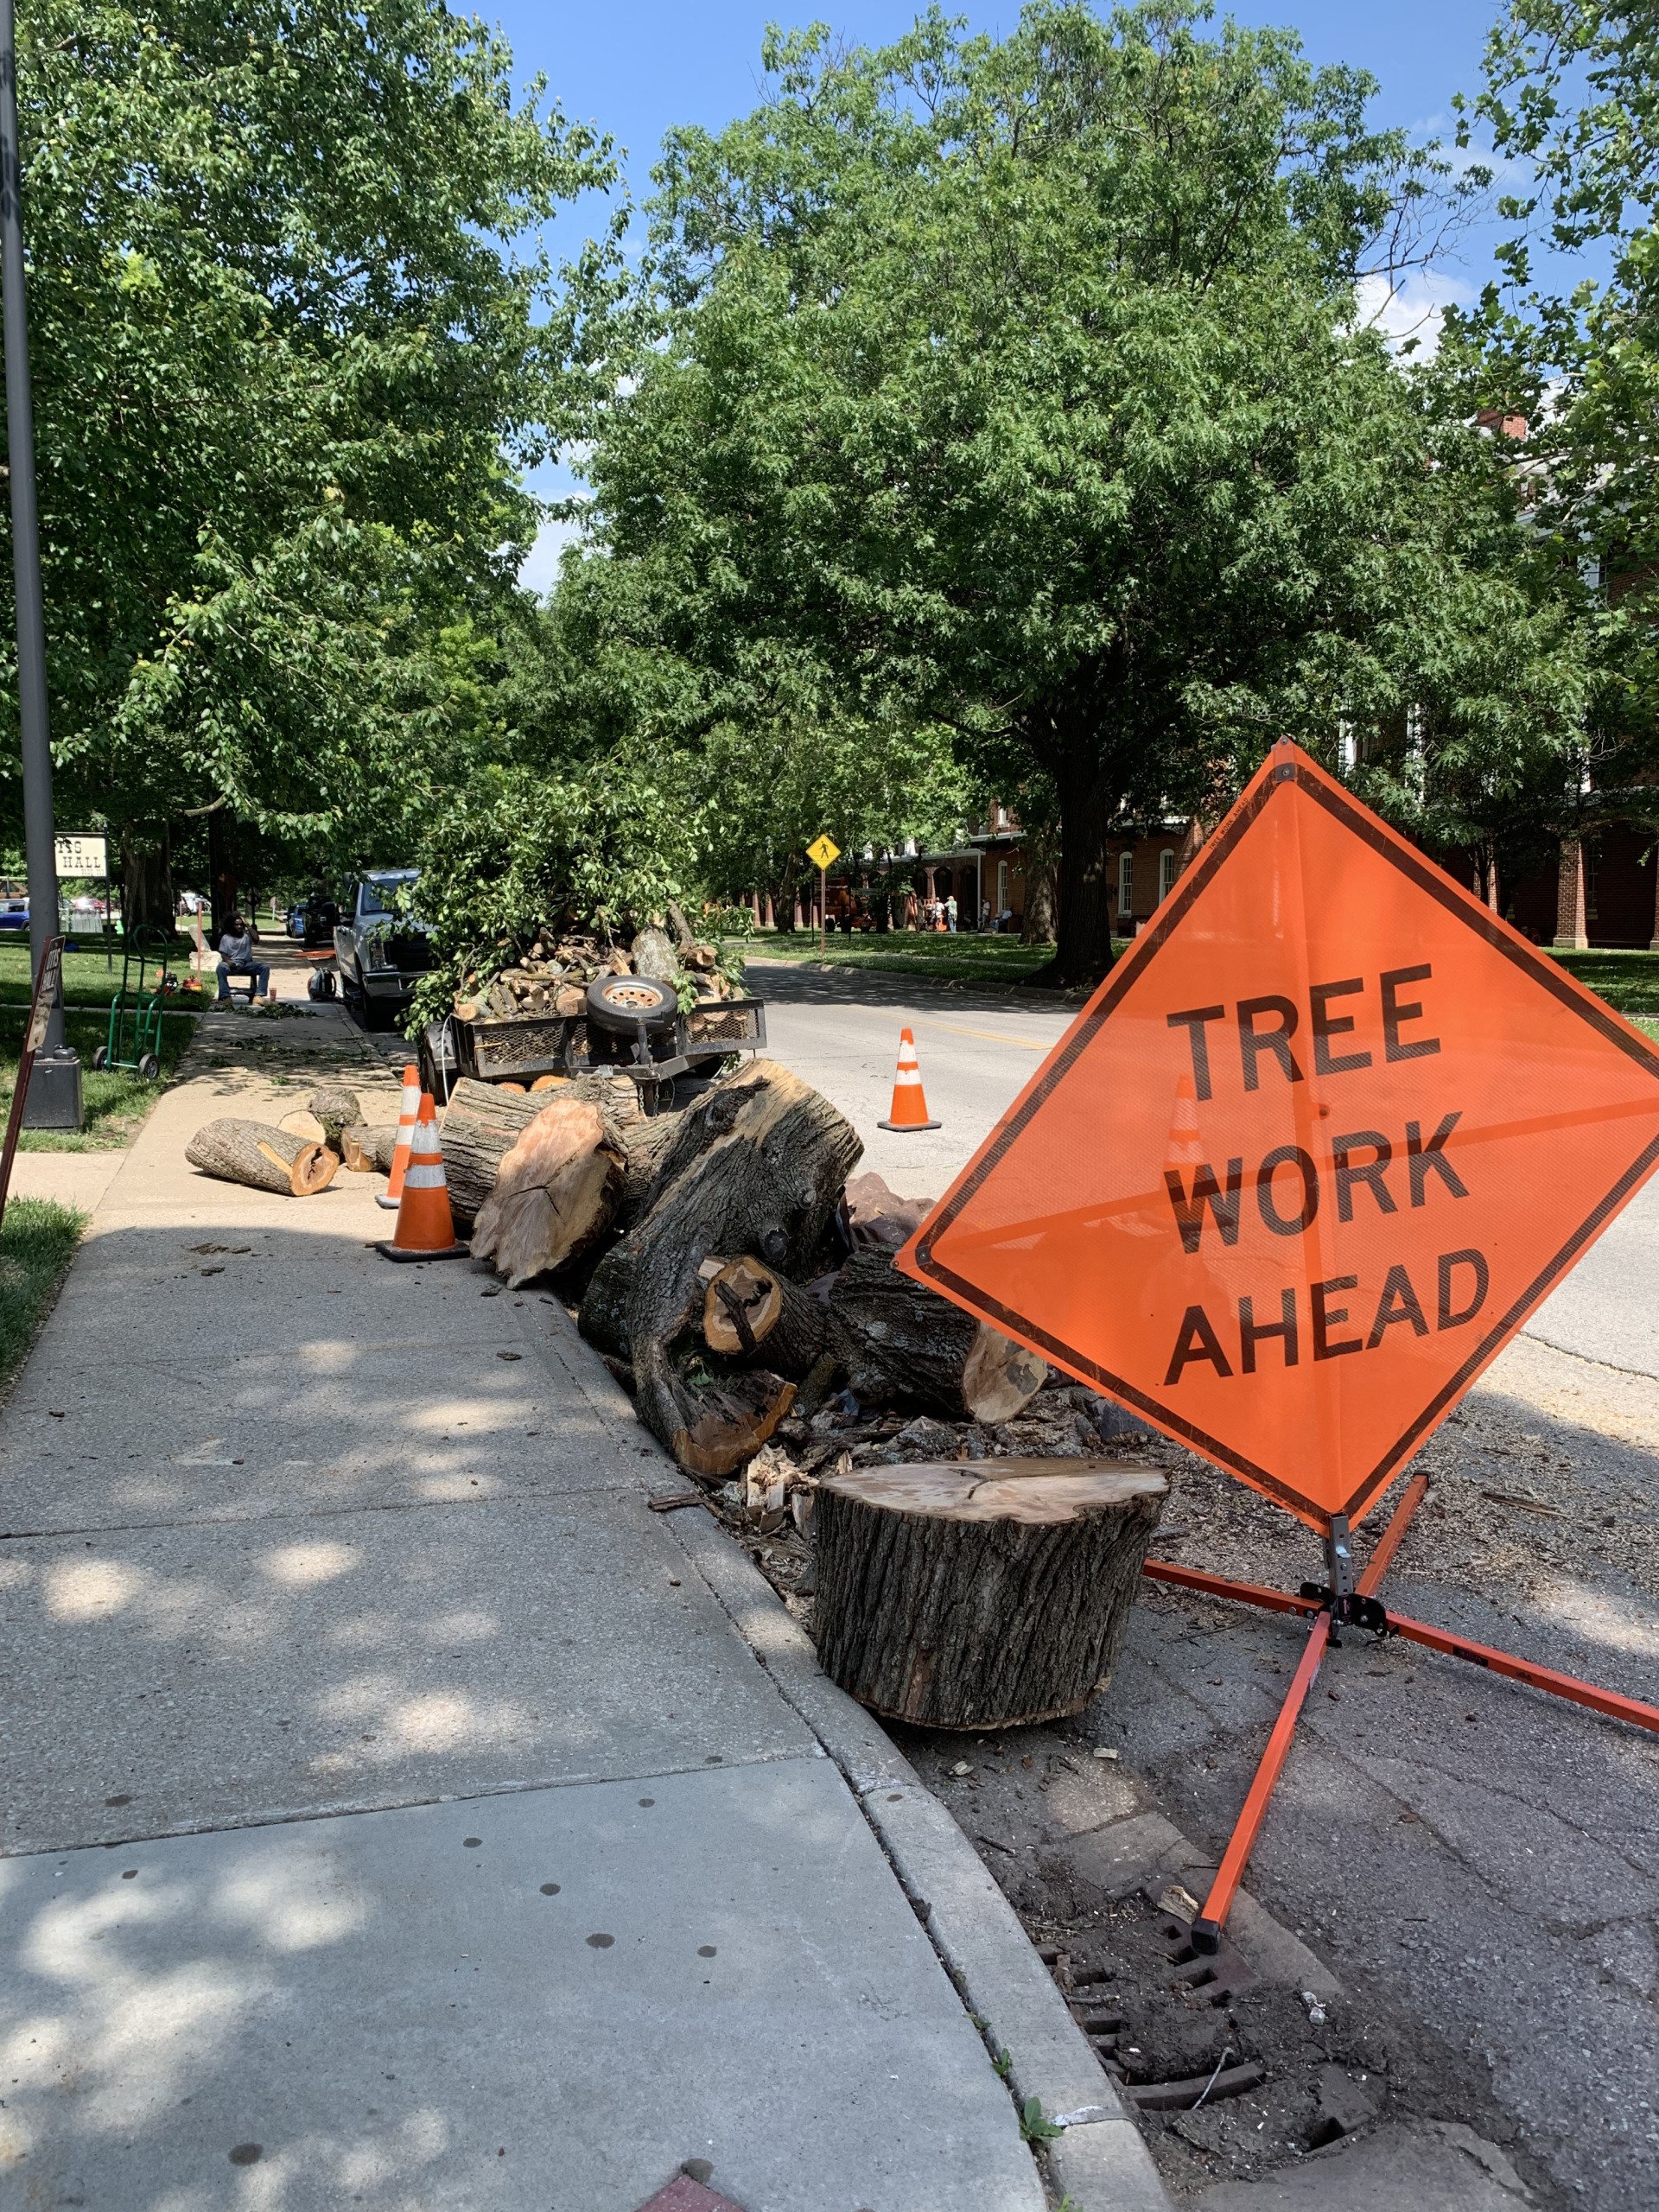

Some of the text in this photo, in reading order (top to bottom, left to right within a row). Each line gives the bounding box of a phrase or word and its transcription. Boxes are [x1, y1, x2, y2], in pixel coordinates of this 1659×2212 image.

[63, 856, 100, 868] HALL
[1166, 963, 1441, 1102] TREE
[1164, 1110, 1470, 1255] WORK
[1163, 1248, 1491, 1386] AHEAD
